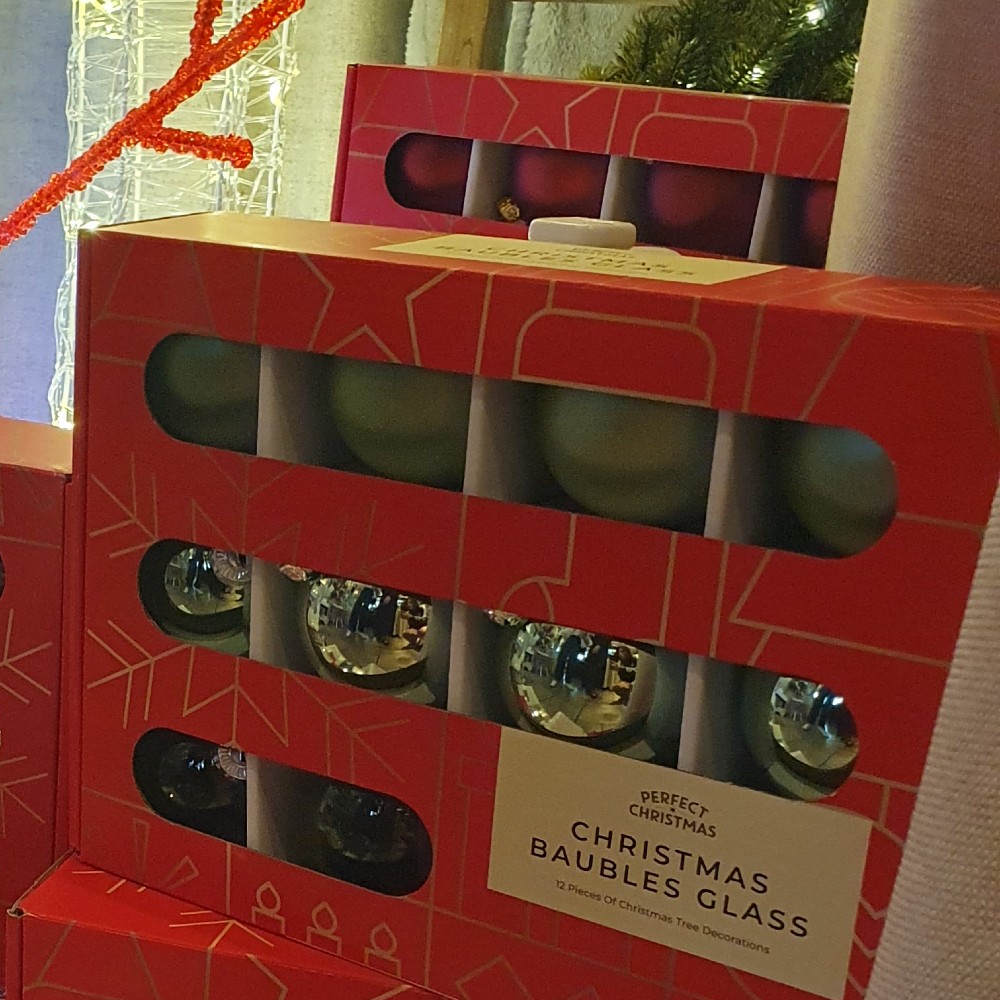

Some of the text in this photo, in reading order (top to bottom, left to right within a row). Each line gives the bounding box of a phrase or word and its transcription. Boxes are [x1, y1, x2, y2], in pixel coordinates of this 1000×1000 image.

[629, 804, 717, 838] CHRISTMAS
[641, 790, 709, 819] PERFECT
[530, 837, 809, 938] BAUBLES GLASS
[571, 821, 769, 894] CHRISTMAS
[556, 879, 771, 955] 12 Pieces Of Christmas Tree Decorations
